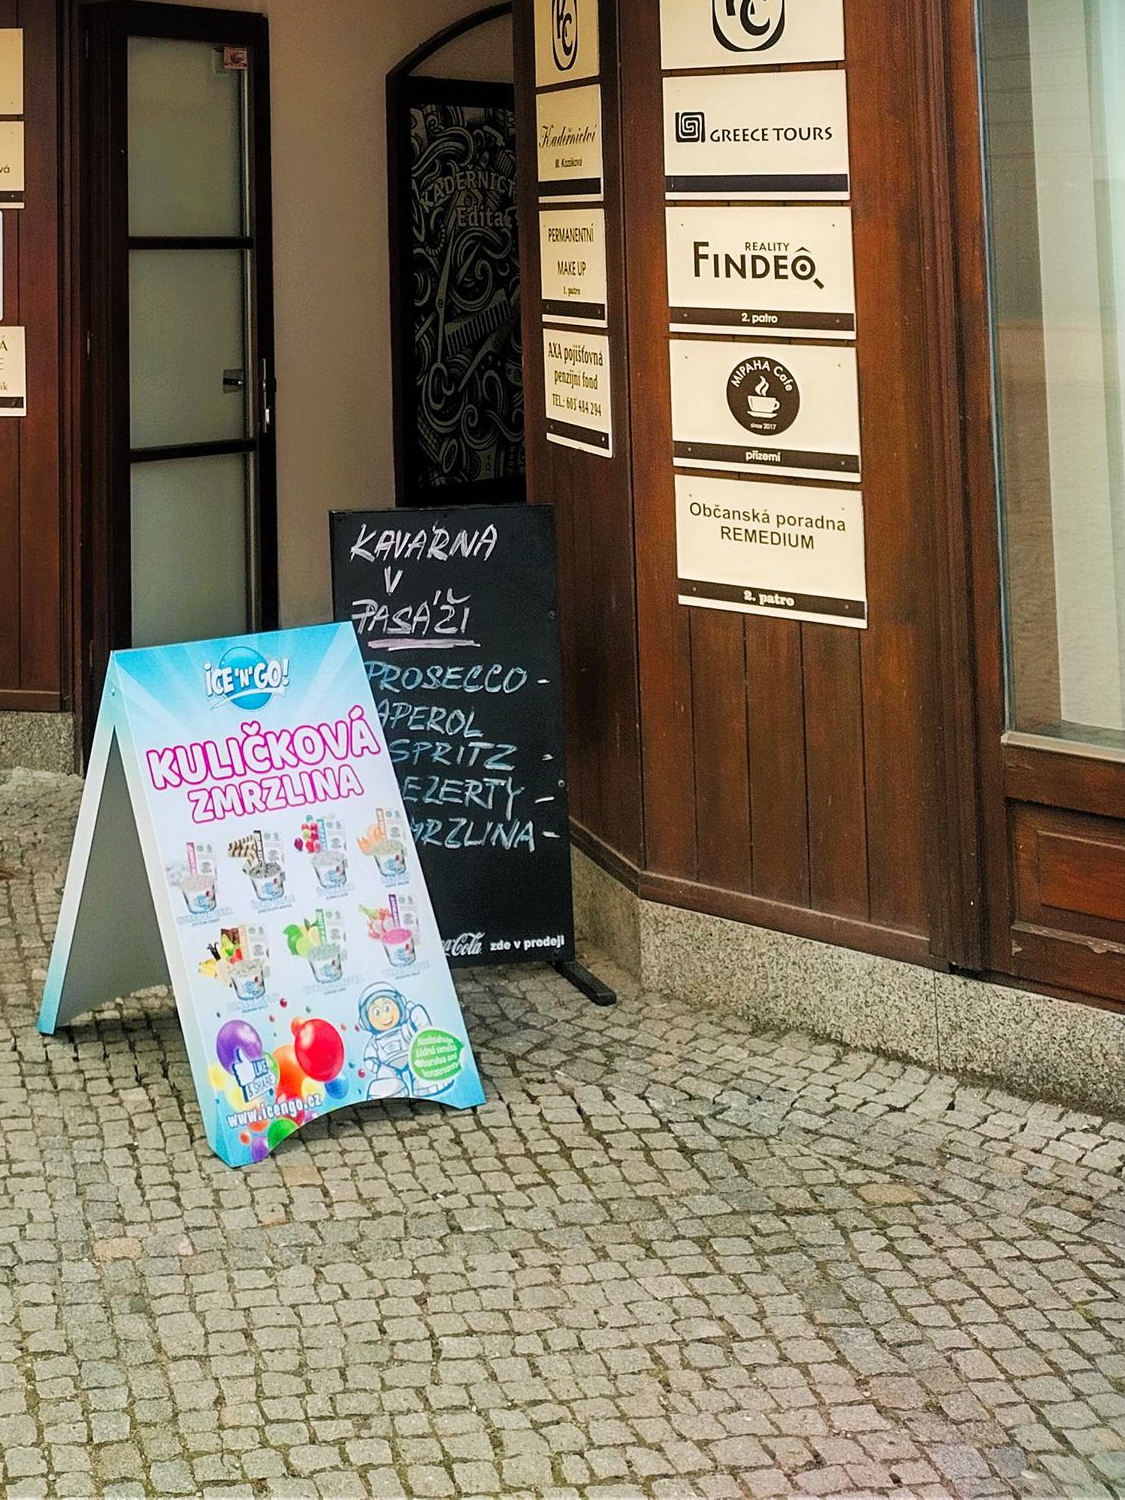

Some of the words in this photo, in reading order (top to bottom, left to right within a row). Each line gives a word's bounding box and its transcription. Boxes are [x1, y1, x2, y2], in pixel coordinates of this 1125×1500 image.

[710, 128, 769, 143] GREECE
[772, 126, 833, 142] TOURS
[548, 222, 595, 243] PERMANENTNÍ
[745, 241, 790, 252] REALITY
[557, 260, 577, 276] MAKE
[577, 261, 587, 276] UP
[741, 312, 751, 323] 2.
[751, 313, 778, 324] patro
[564, 344, 604, 367] pojišťovna
[582, 371, 598, 390] fond
[730, 359, 771, 389] MIPAHA
[773, 366, 793, 393] Cafe
[745, 450, 781, 462] přízemí
[689, 502, 770, 524] Občanská
[776, 514, 846, 532] poradna
[720, 526, 815, 550] REMEDIUM
[743, 590, 756, 602] 2.
[759, 593, 795, 607] patro
[351, 587, 472, 636] PASÁŽI
[375, 698, 484, 738] APEROL
[146, 705, 381, 790] KULIČKOVÁ
[388, 739, 518, 771] SPRITZ
[187, 764, 365, 824] ZMRZLINA
[402, 775, 525, 821] EZERTY
[490, 938, 512, 952] zde
[514, 940, 522, 949] v
[524, 934, 565, 951] prodeji
[227, 1093, 323, 1129] www.icengo.cz
